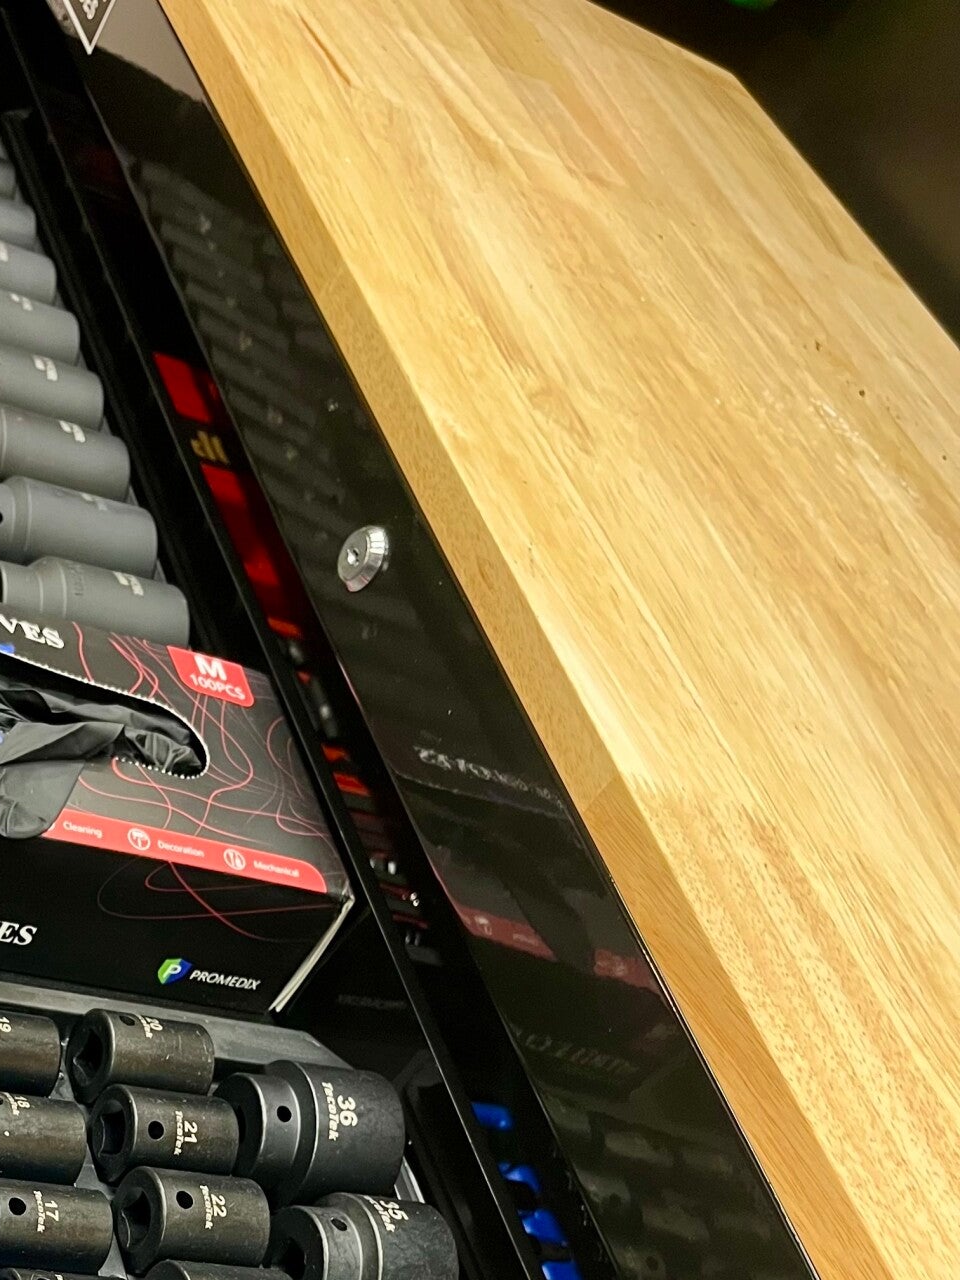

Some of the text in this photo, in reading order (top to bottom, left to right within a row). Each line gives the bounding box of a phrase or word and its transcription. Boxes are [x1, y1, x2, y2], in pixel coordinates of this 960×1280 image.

[194, 654, 228, 682] M
[189, 673, 247, 702] 100PCS
[62, 820, 103, 839] Cleaning
[158, 838, 205, 859] Decoration
[253, 860, 300, 878] Mechanical
[189, 969, 261, 992] PROMEDIX
[14, 1095, 31, 1110] 18
[337, 1094, 359, 1128] 36
[183, 1121, 198, 1145] 21
[43, 1199, 60, 1222] 17
[212, 1194, 228, 1218] 22
